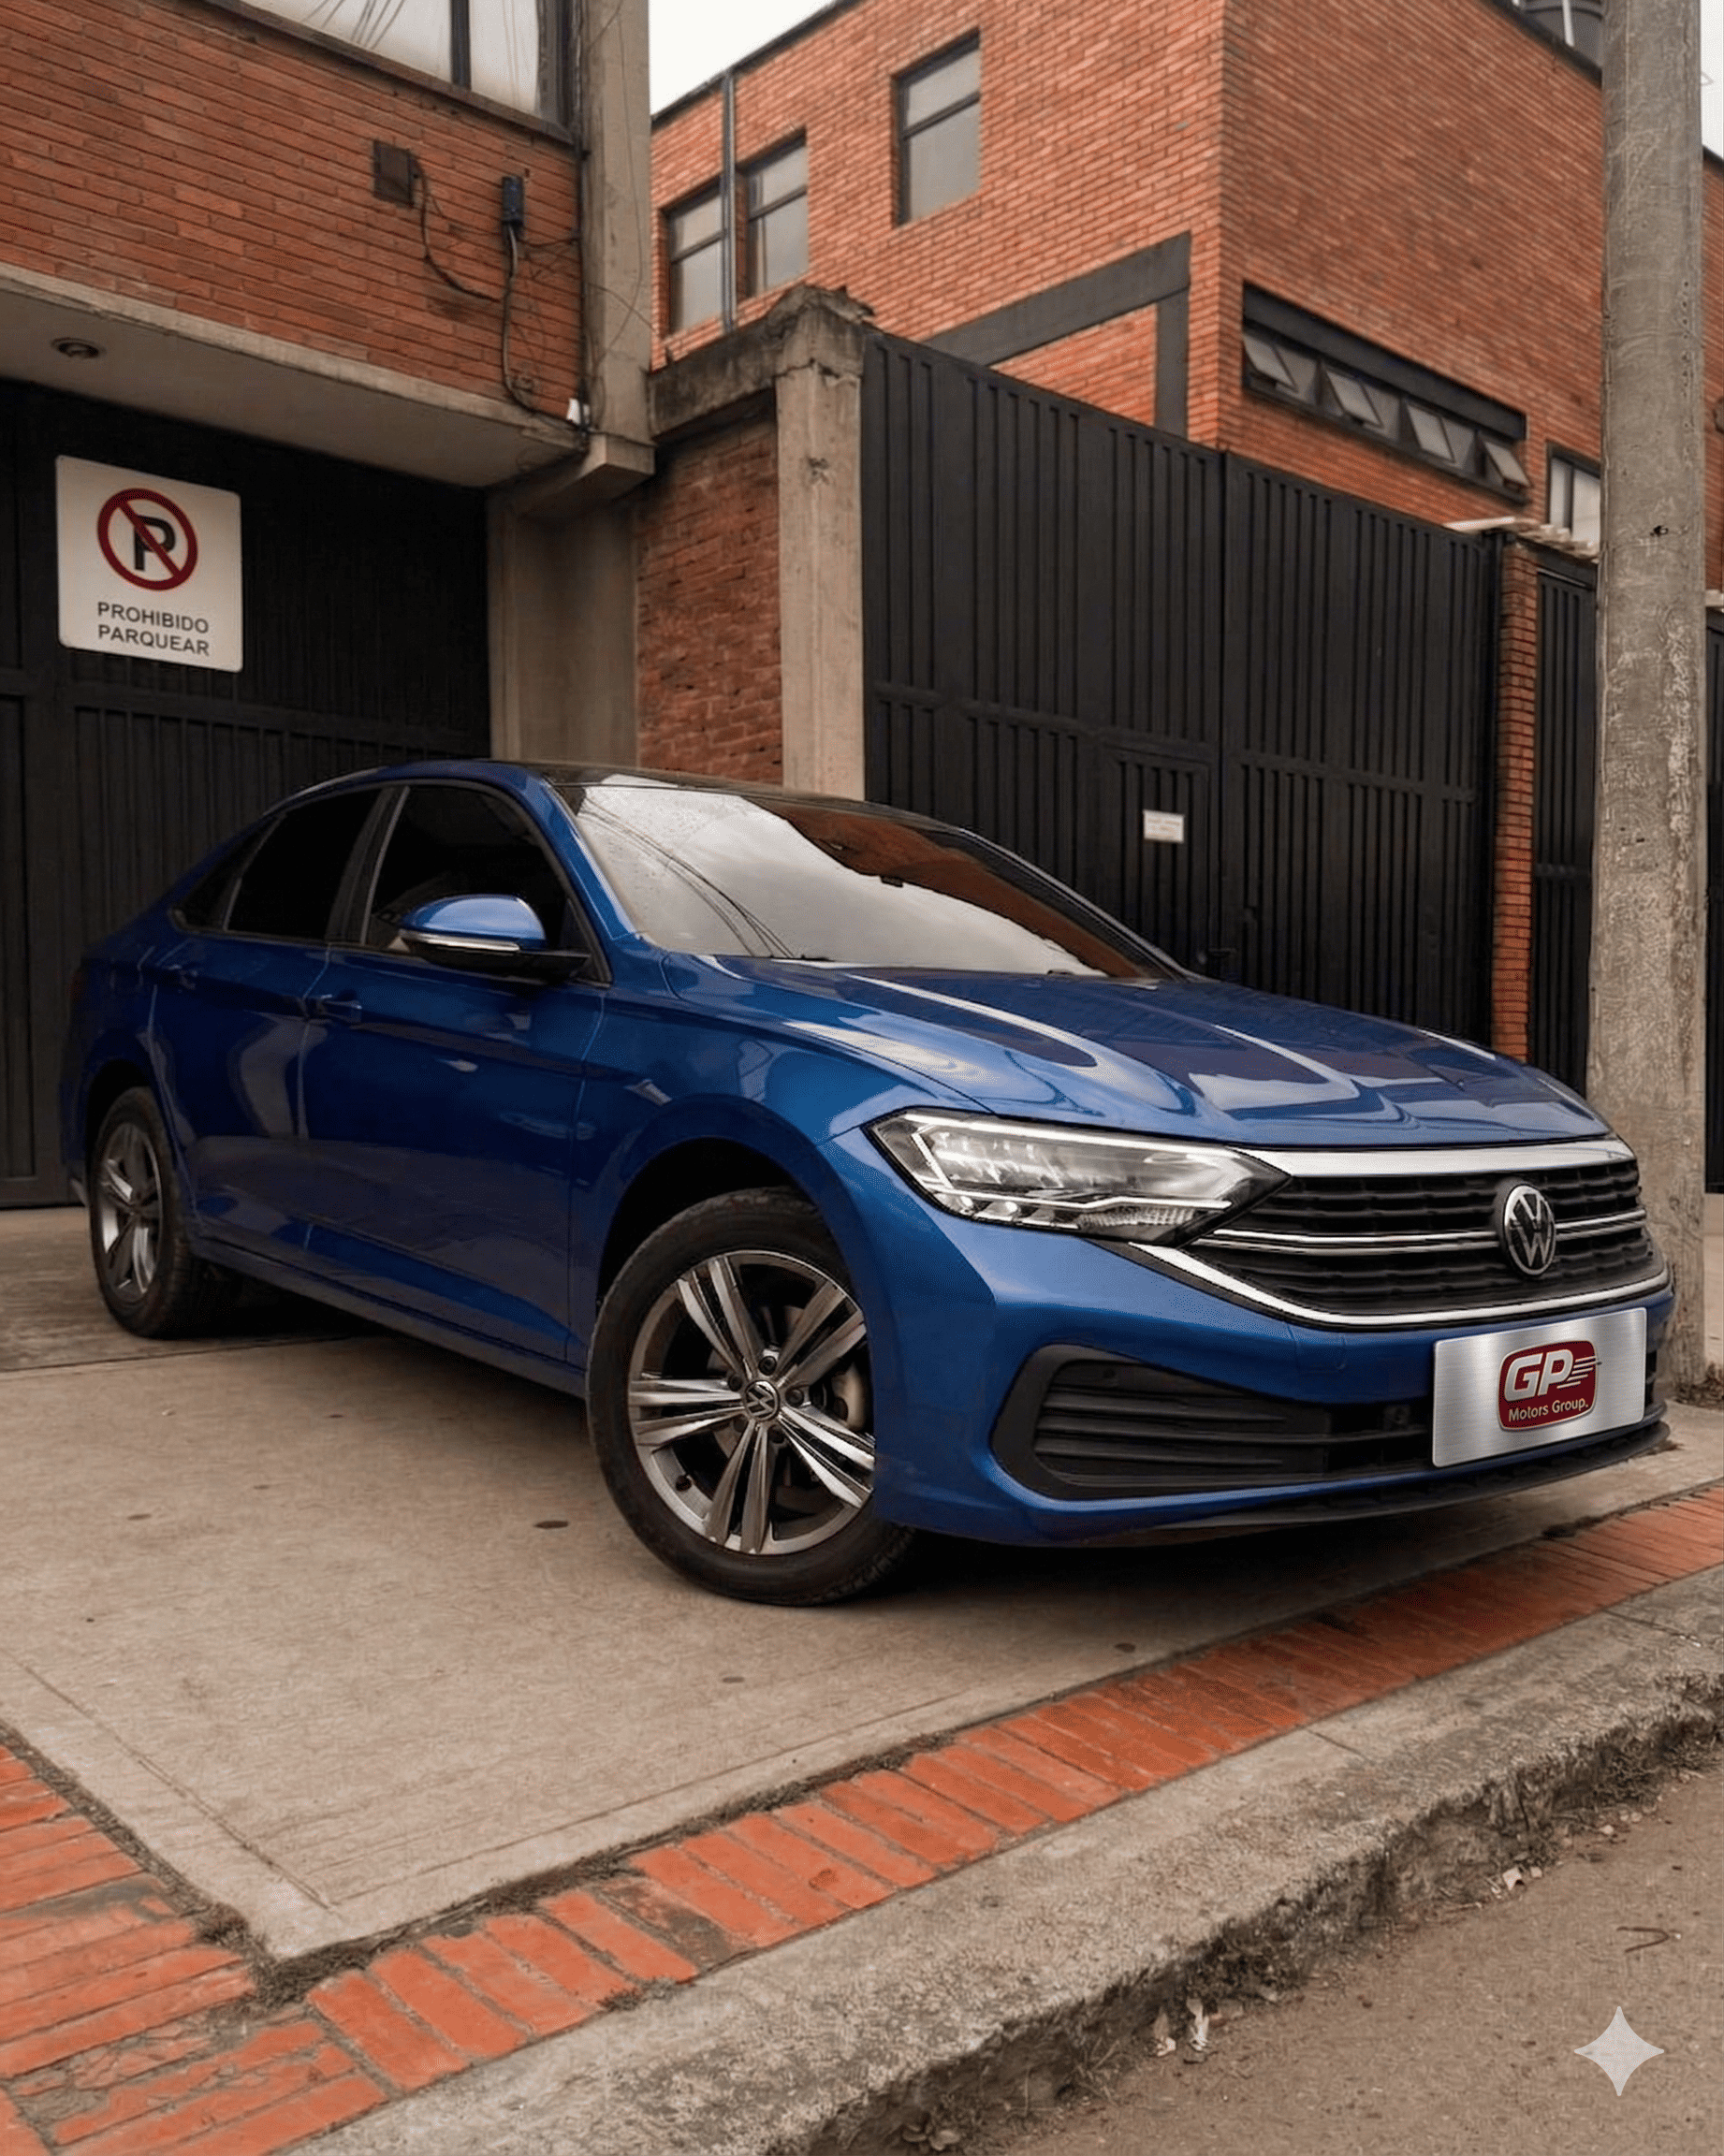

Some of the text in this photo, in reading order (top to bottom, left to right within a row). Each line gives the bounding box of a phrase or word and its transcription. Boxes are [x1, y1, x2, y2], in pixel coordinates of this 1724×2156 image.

[133, 514, 177, 572] P
[97, 601, 209, 634] PROHIBIDO
[97, 624, 210, 656] PARQUEAR
[1504, 1348, 1574, 1402] GP
[1508, 1397, 1589, 1422] Motors Group.
